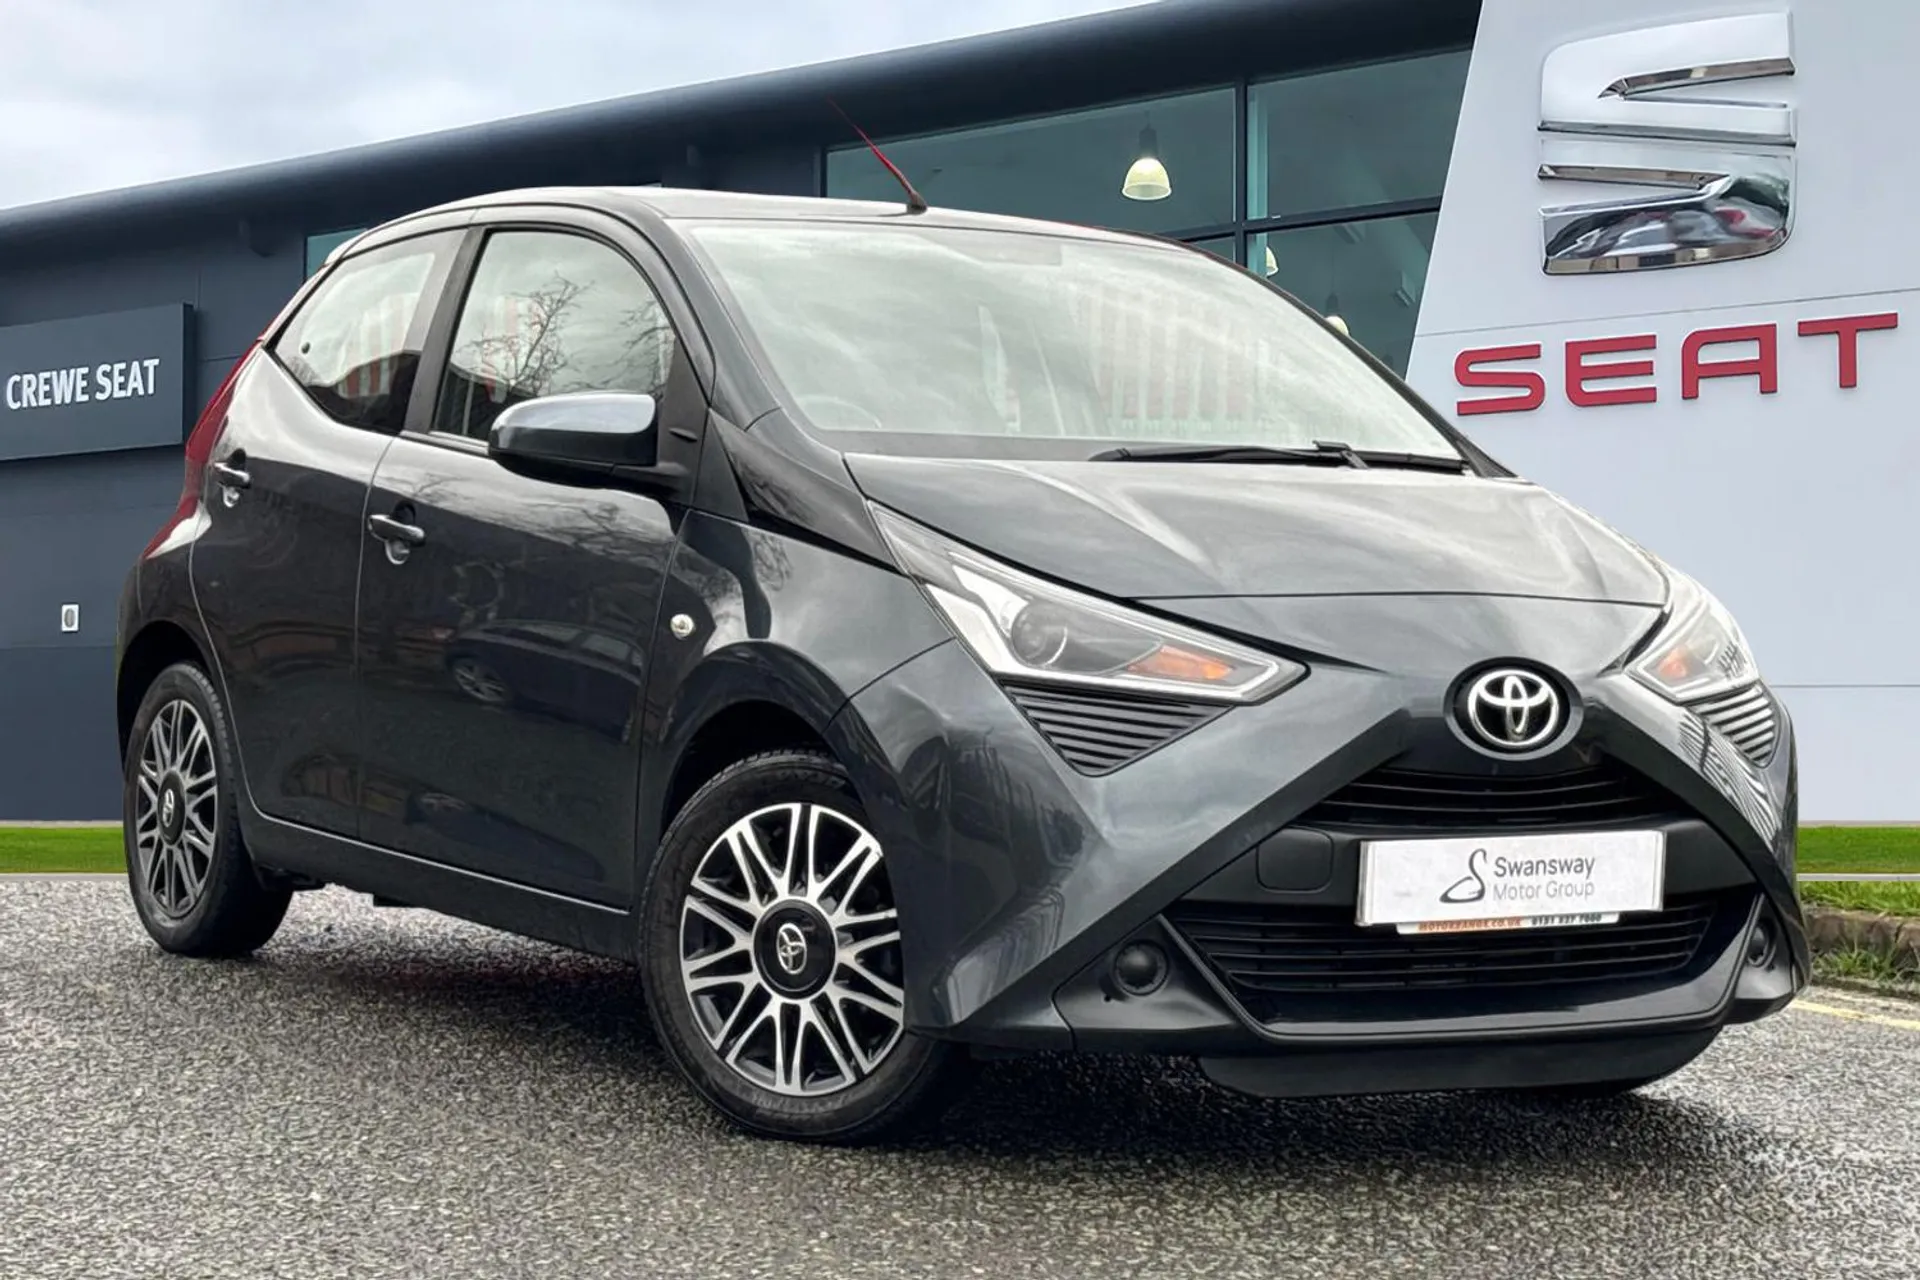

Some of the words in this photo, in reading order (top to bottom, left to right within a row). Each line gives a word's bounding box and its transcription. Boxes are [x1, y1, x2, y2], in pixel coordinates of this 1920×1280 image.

[1454, 312, 1898, 416] SEAT
[6, 366, 89, 410] CREWE
[95, 358, 160, 401] SEAT
[1494, 856, 1595, 880] Swansway
[1493, 883, 1541, 901] Motor
[1546, 879, 1595, 899] Group
